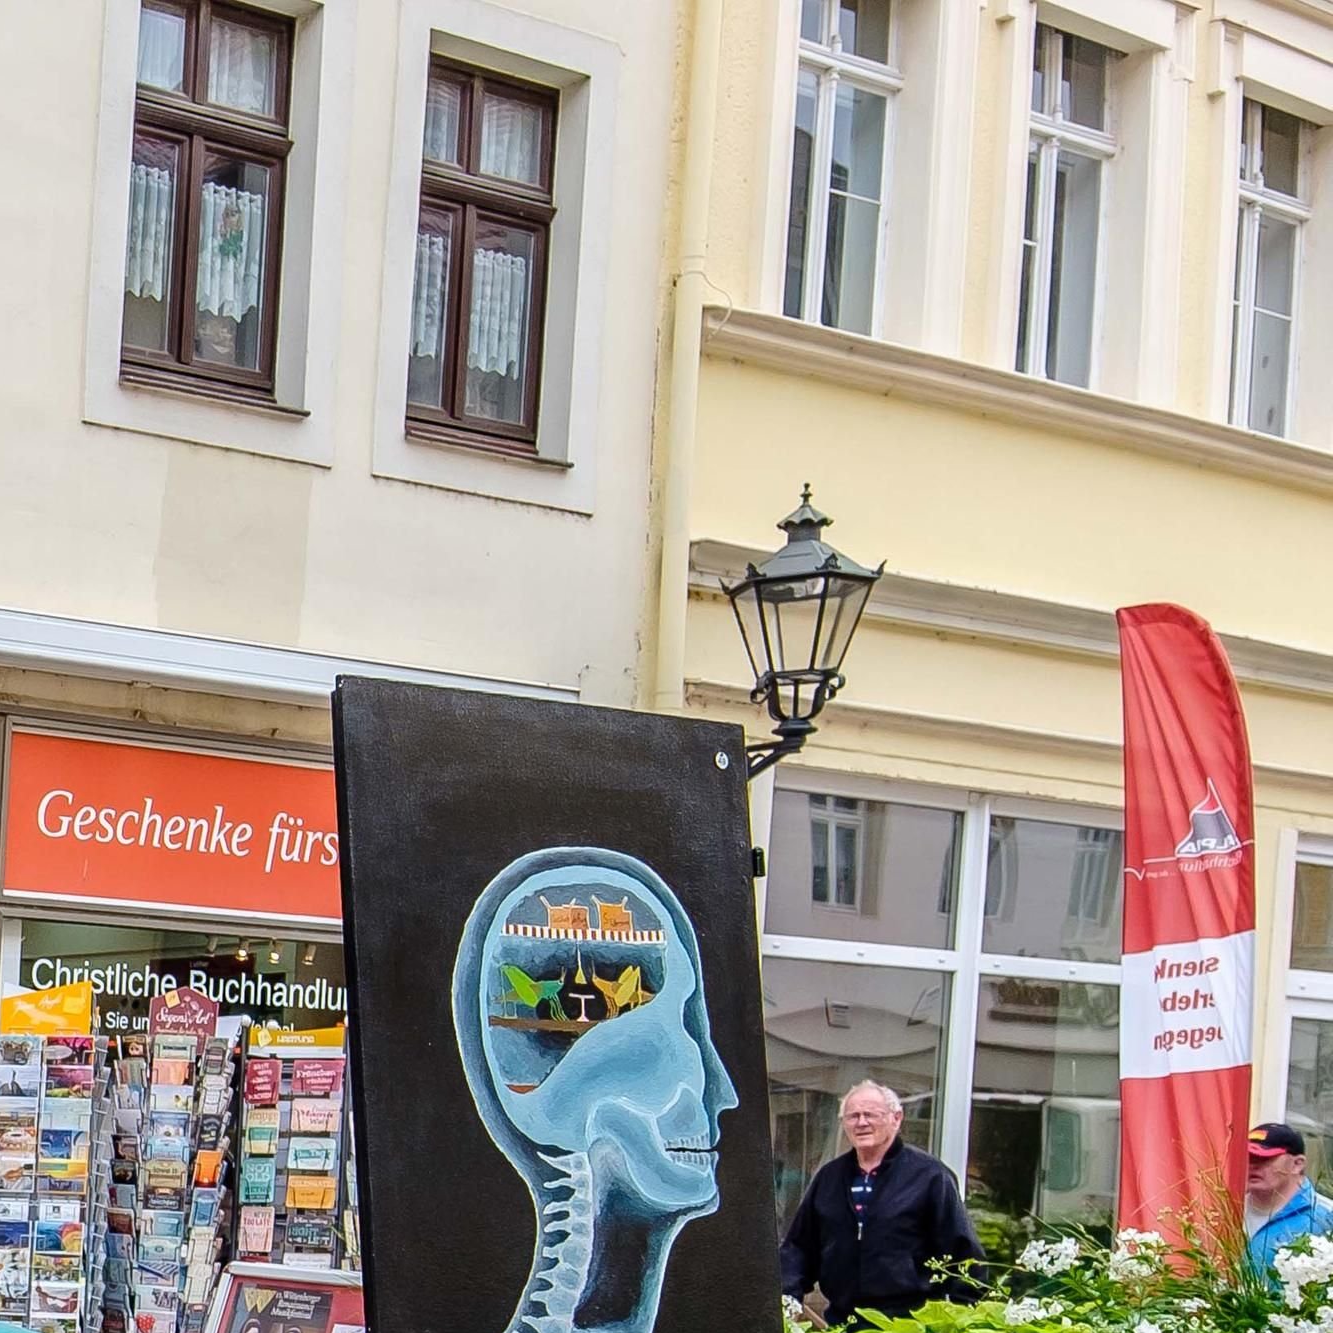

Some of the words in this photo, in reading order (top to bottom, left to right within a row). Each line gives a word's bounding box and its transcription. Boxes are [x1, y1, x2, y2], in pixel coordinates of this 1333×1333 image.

[37, 789, 253, 857] Geschenke
[31, 957, 177, 998] Christliche
[105, 1011, 129, 1030] Sie
[133, 1016, 150, 1031] un
